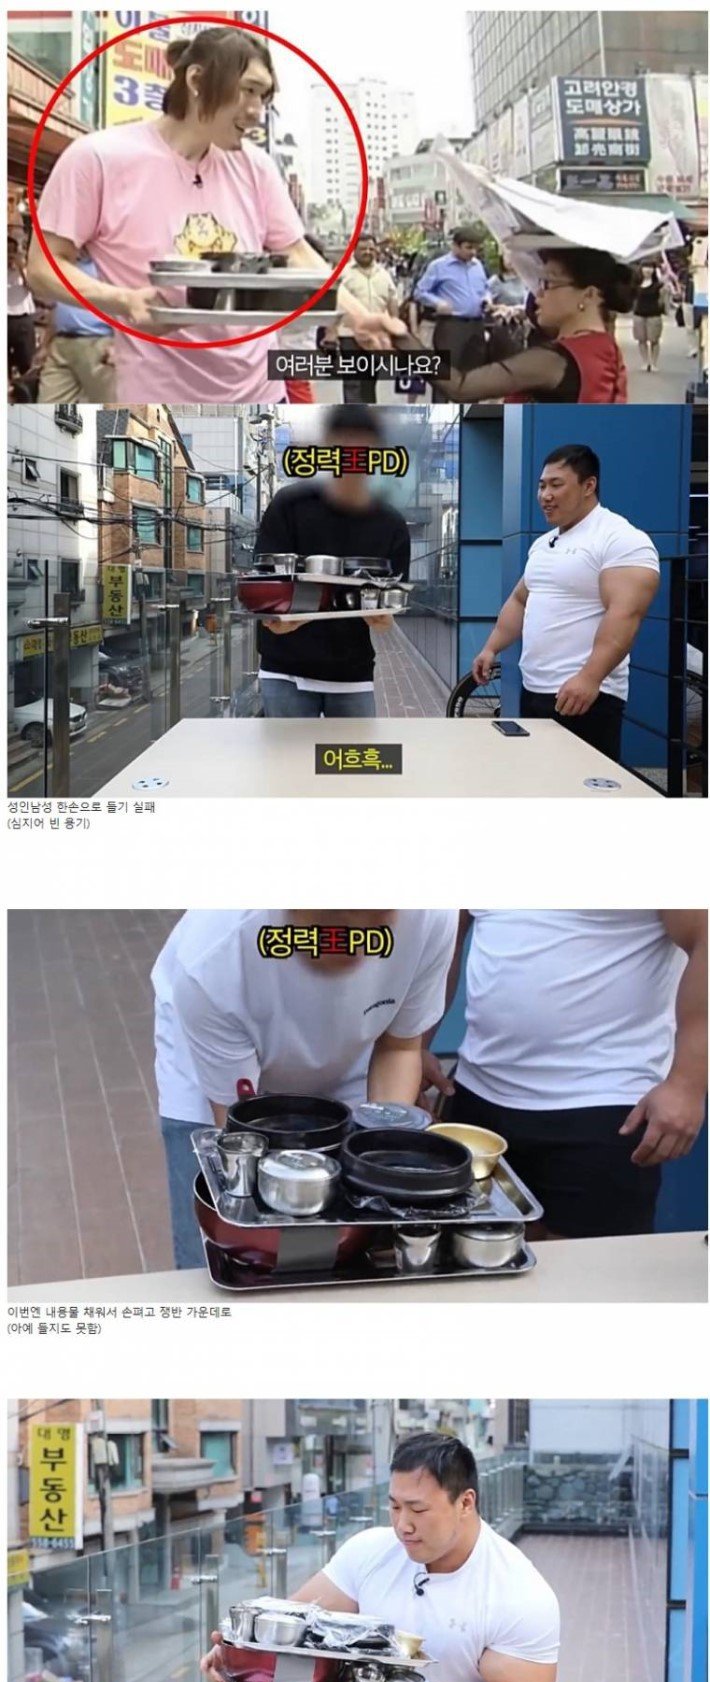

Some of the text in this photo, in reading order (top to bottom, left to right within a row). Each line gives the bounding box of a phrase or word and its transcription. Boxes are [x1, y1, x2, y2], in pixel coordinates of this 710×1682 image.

[564, 79, 637, 98] 고려안경
[565, 98, 641, 116] 도매상가
[40, 1447, 68, 1532] 부동산
